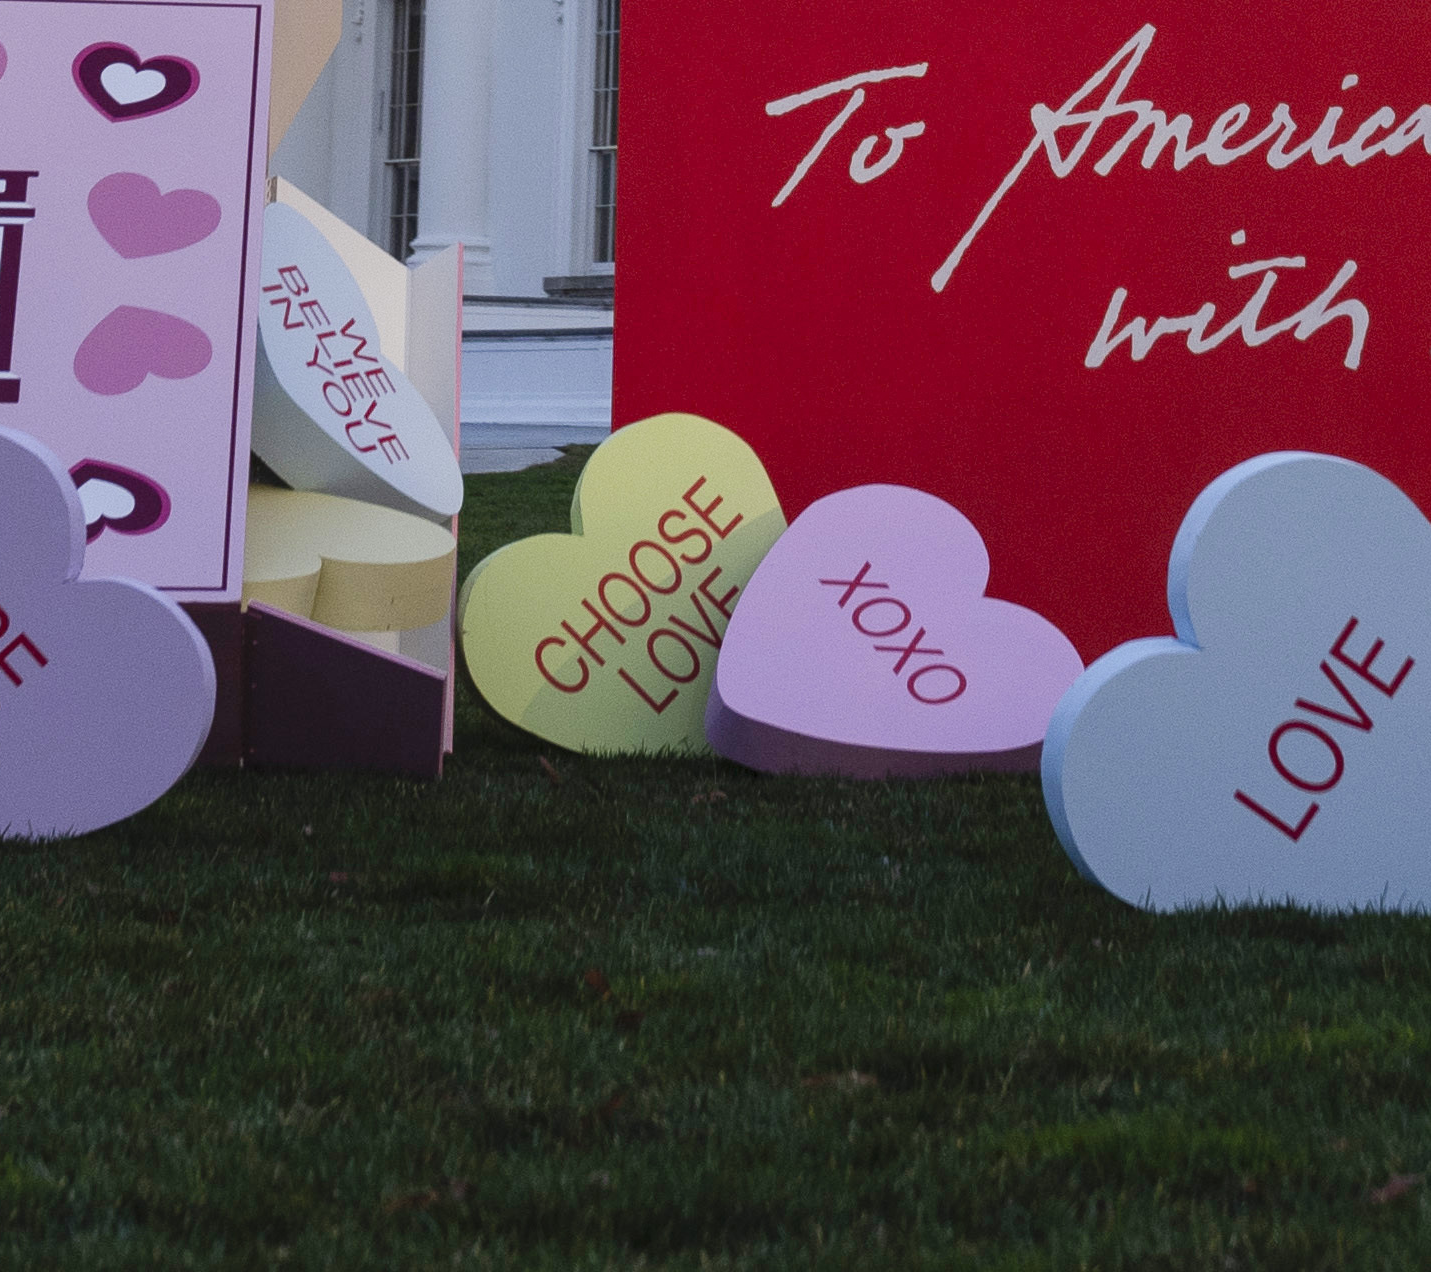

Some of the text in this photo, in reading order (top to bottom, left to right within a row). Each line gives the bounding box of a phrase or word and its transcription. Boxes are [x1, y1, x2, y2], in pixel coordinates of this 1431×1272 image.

[765, 62, 929, 208] To
[1084, 229, 1371, 370] with
[534, 475, 744, 694] CHOOSE
[818, 561, 968, 705] XOXO
[1233, 615, 1416, 843] LOVE
